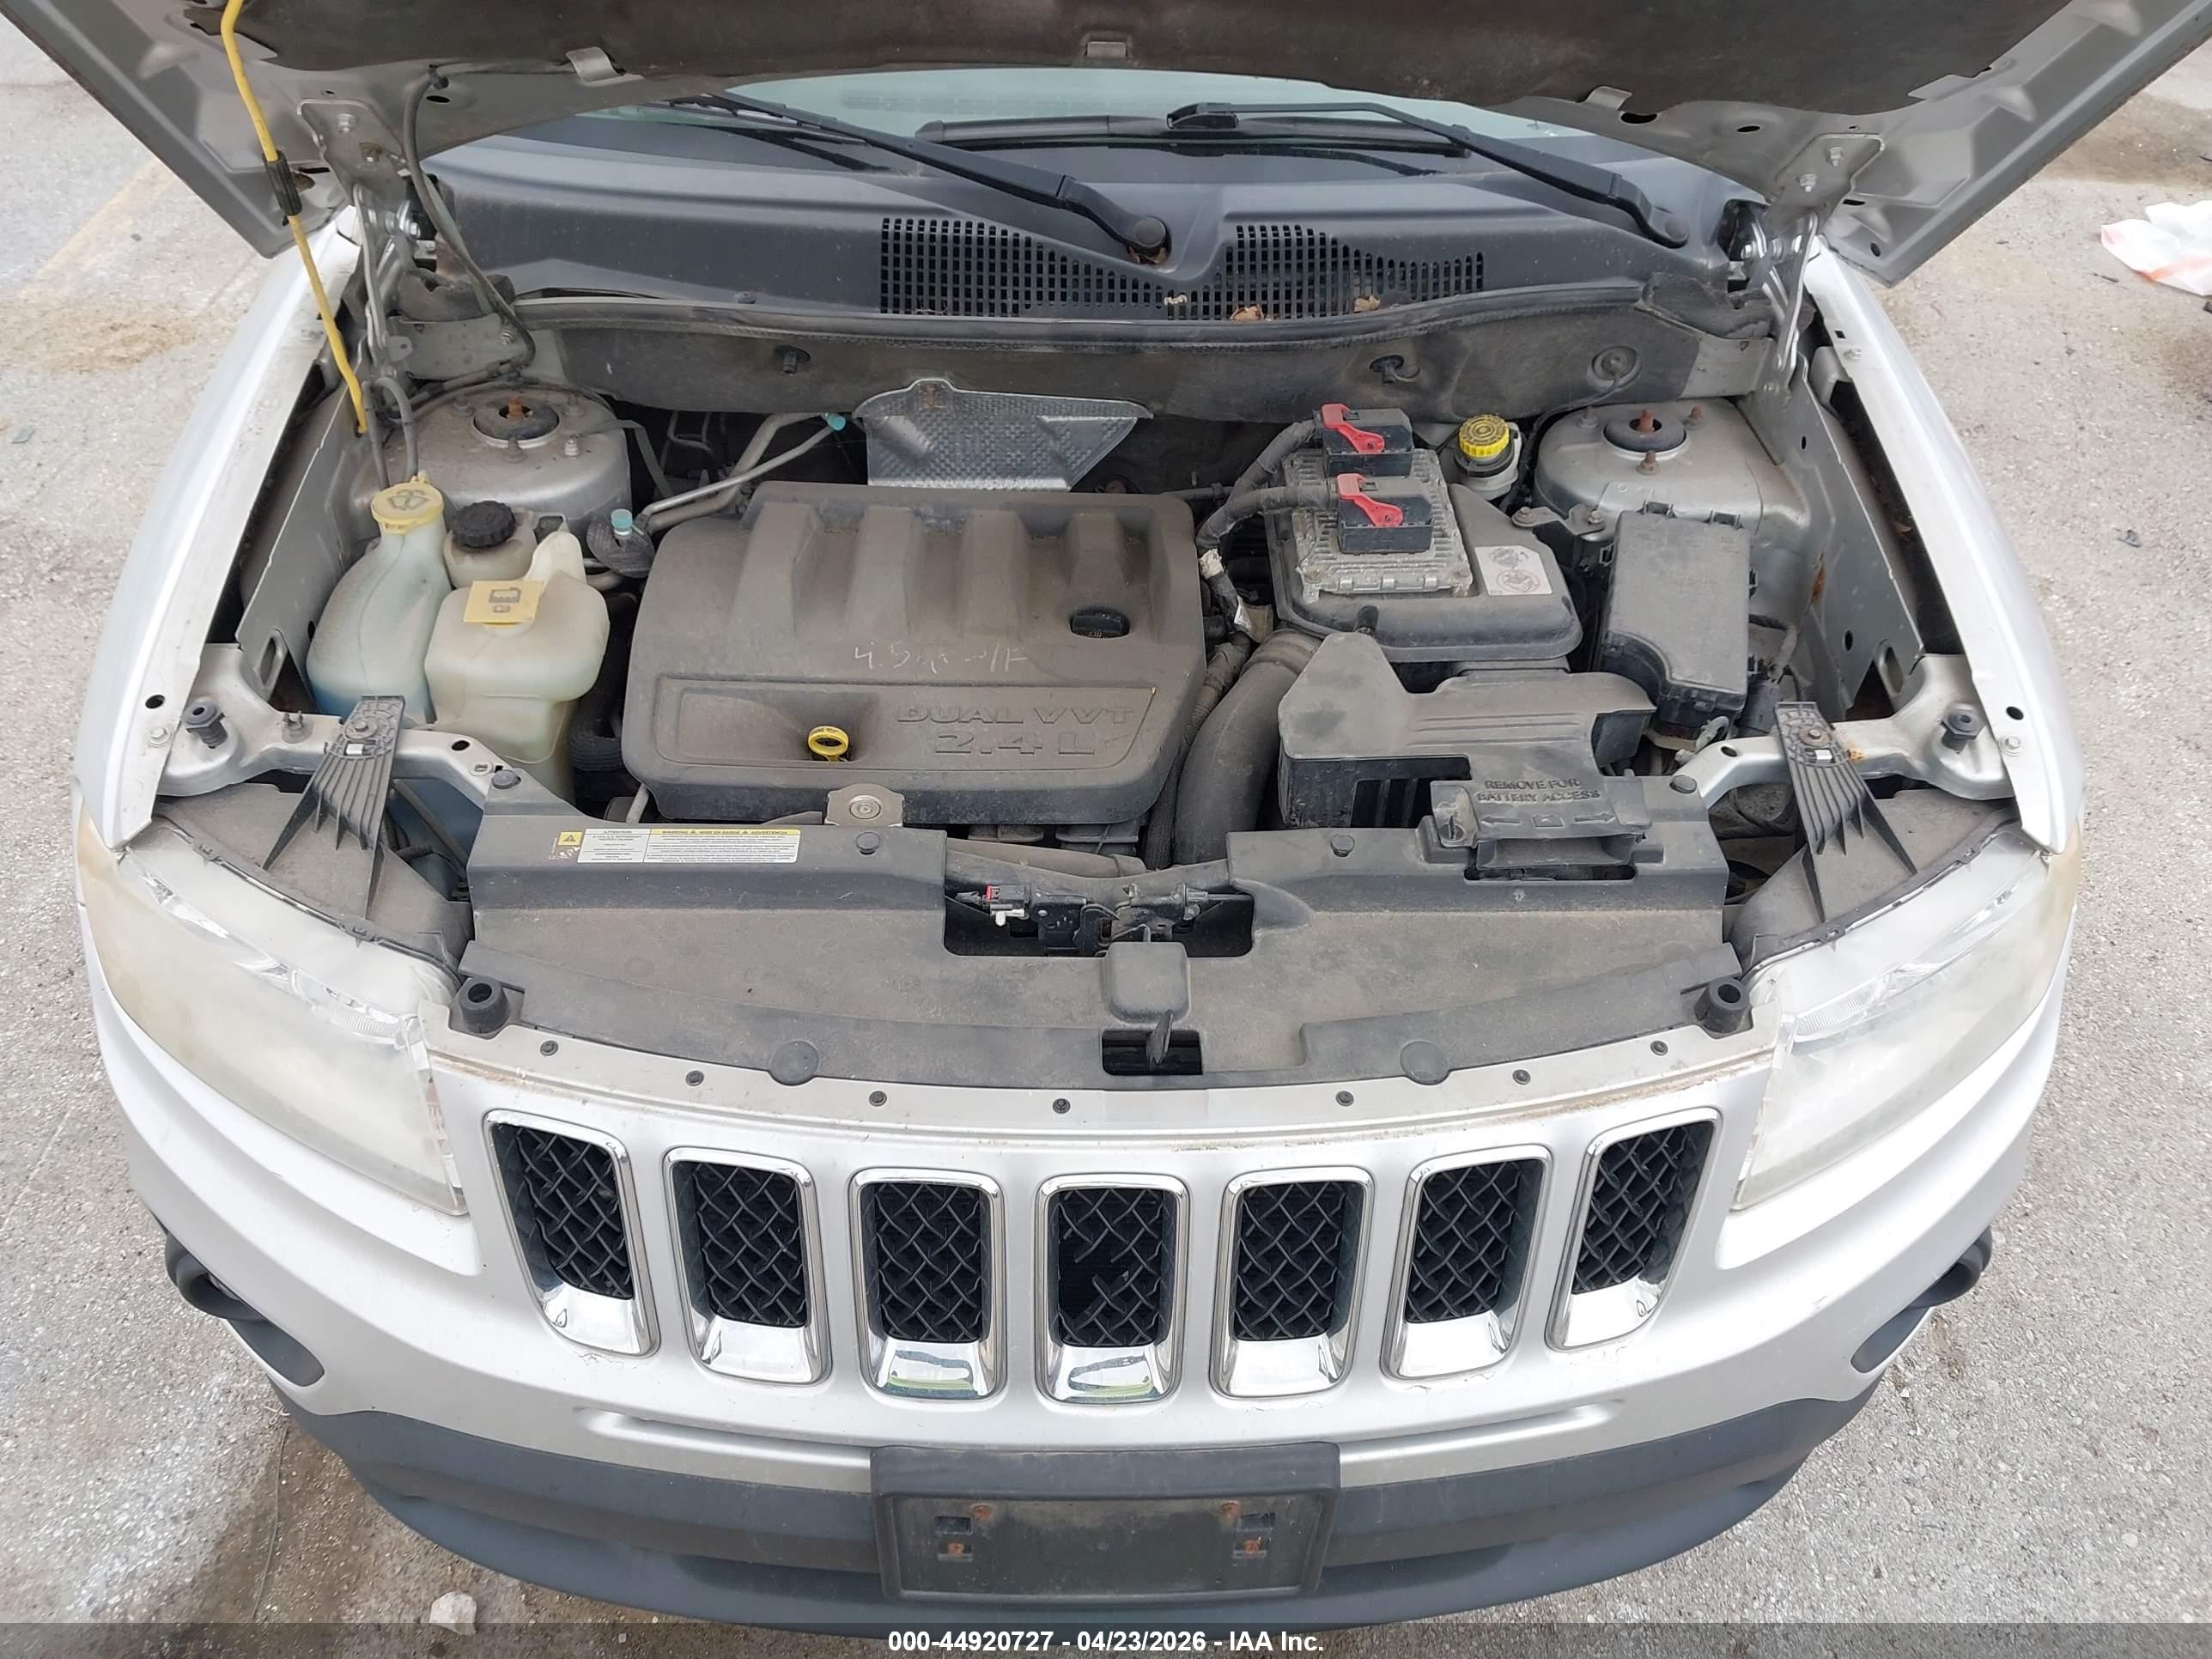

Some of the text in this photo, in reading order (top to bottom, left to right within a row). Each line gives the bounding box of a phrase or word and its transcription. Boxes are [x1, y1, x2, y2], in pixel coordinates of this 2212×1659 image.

[897, 707, 1133, 725] DUAL VVT
[1484, 778, 1582, 791] REMOVE FOR
[1476, 789, 1601, 803] BATTERY ACCESS
